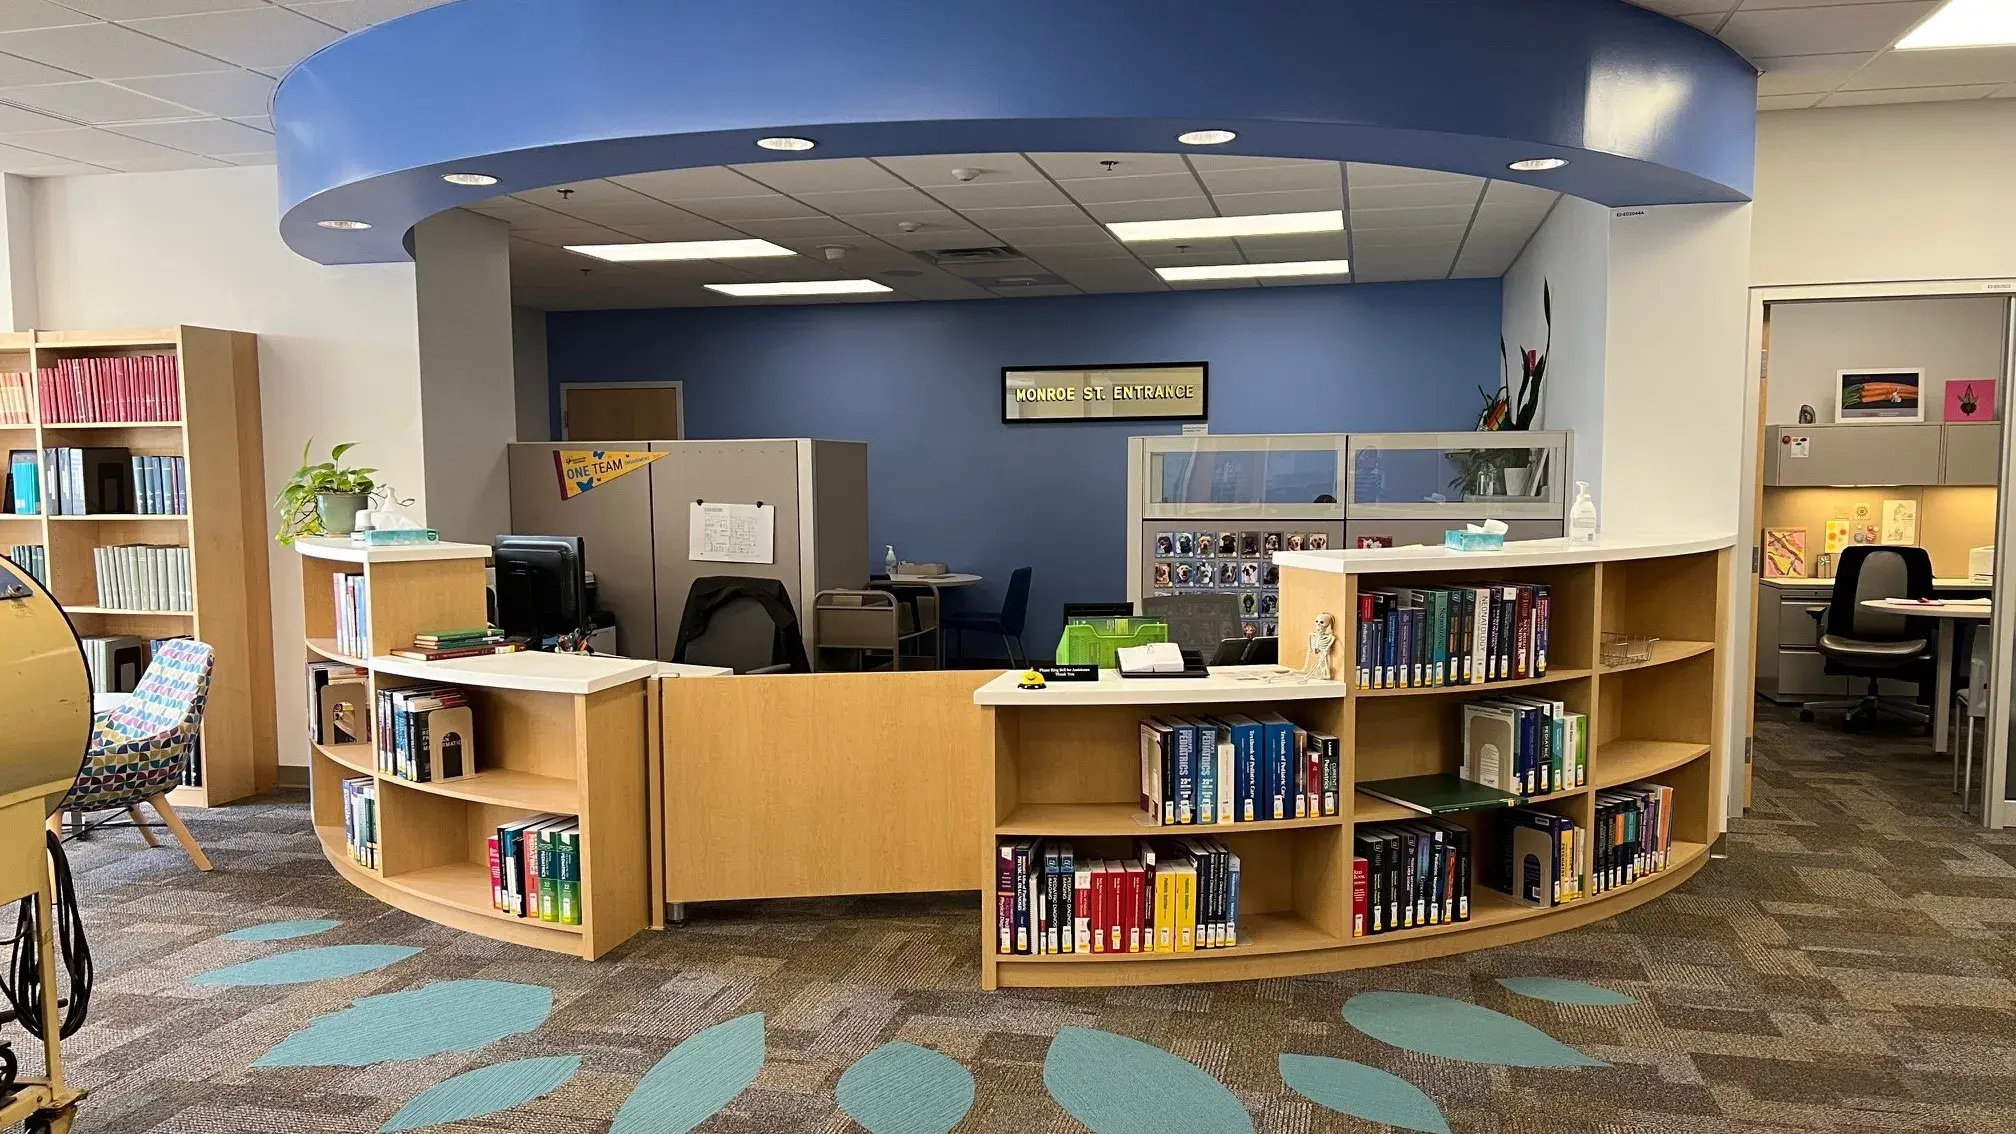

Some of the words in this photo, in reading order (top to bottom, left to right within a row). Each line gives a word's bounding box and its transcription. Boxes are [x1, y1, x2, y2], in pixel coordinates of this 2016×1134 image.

[1016, 386, 1076, 402] MONROE
[1083, 386, 1107, 402] ST.
[1113, 384, 1194, 400] ENTRANCE
[567, 466, 590, 480] ONE
[592, 458, 623, 474] TEAM
[1480, 596, 1488, 652] NEONATOLOGY
[1179, 730, 1188, 775] PEDIATRICS
[1201, 730, 1211, 776] PEDIATRICS
